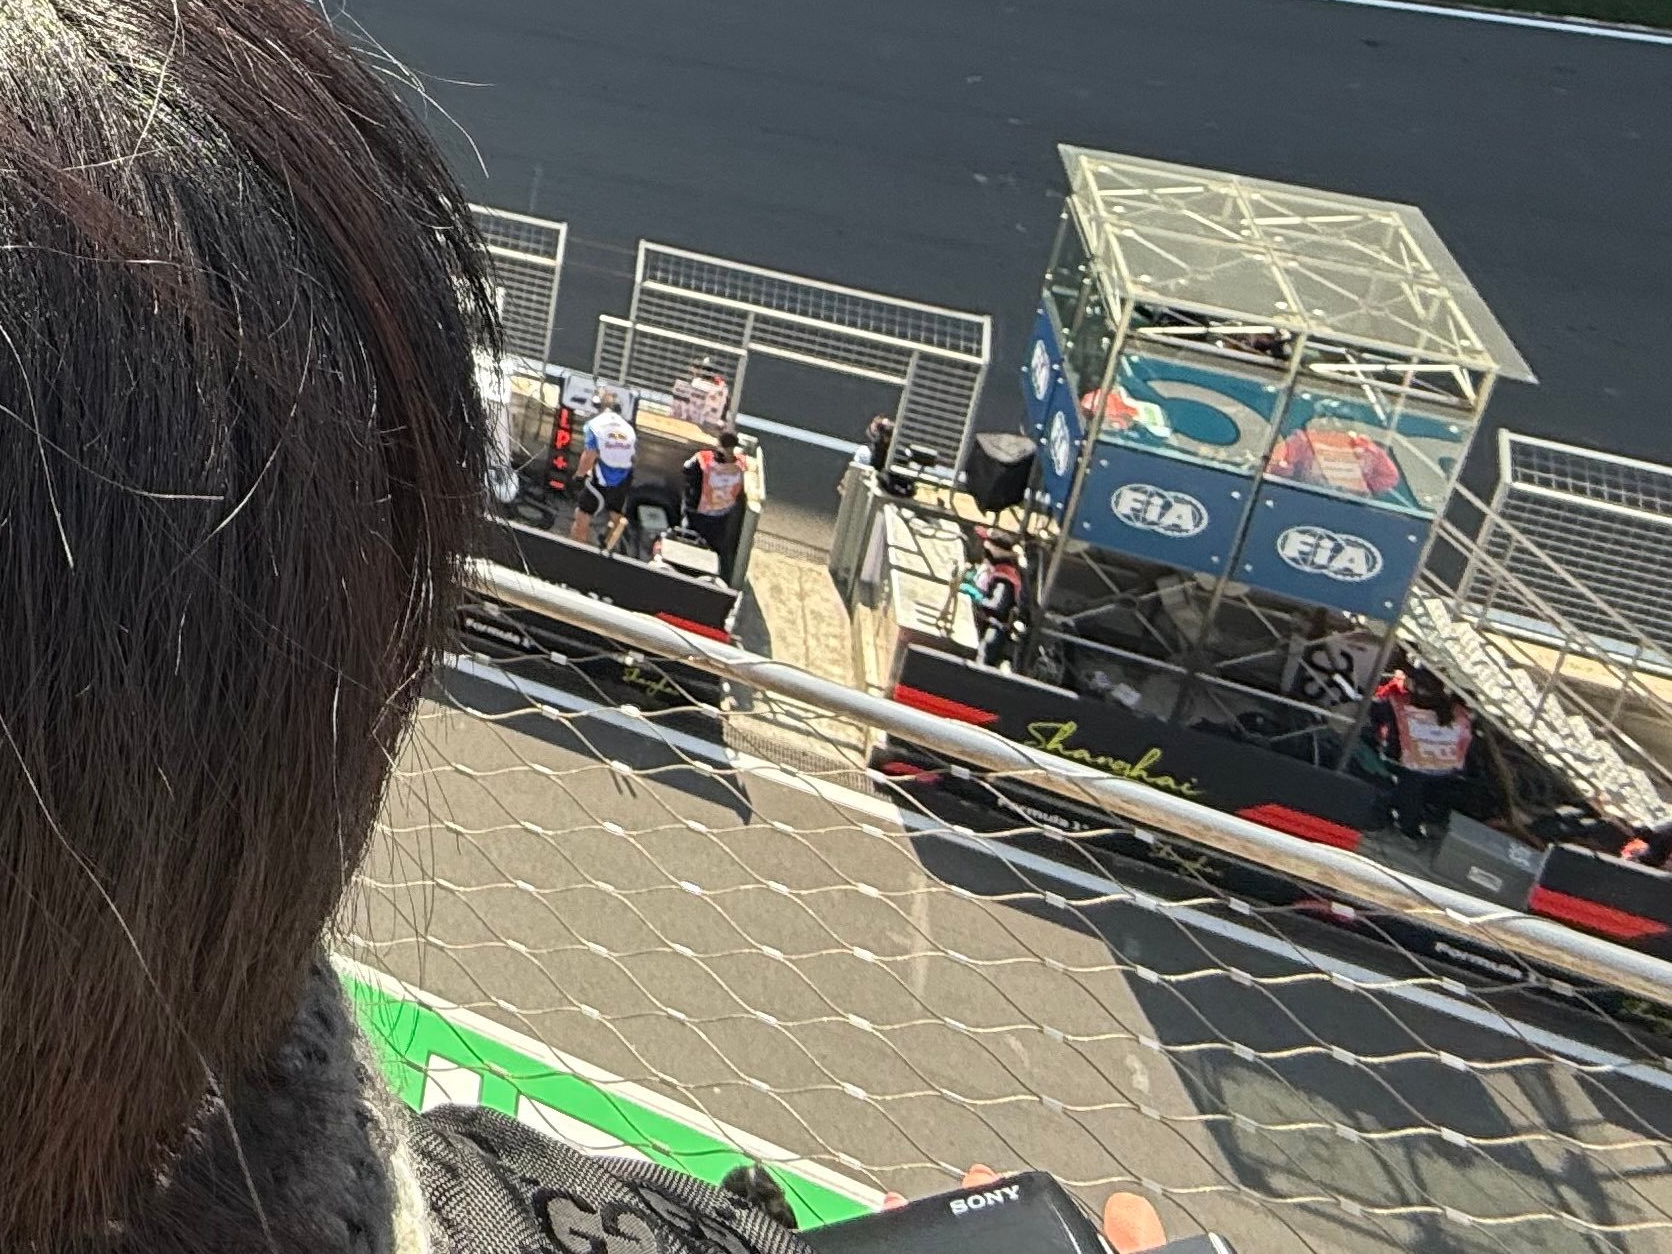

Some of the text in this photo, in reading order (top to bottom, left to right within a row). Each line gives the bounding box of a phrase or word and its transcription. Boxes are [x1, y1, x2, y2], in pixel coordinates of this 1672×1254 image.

[1117, 488, 1197, 534] FIA
[1281, 531, 1368, 577] FIA
[949, 1184, 1021, 1217] SONY
